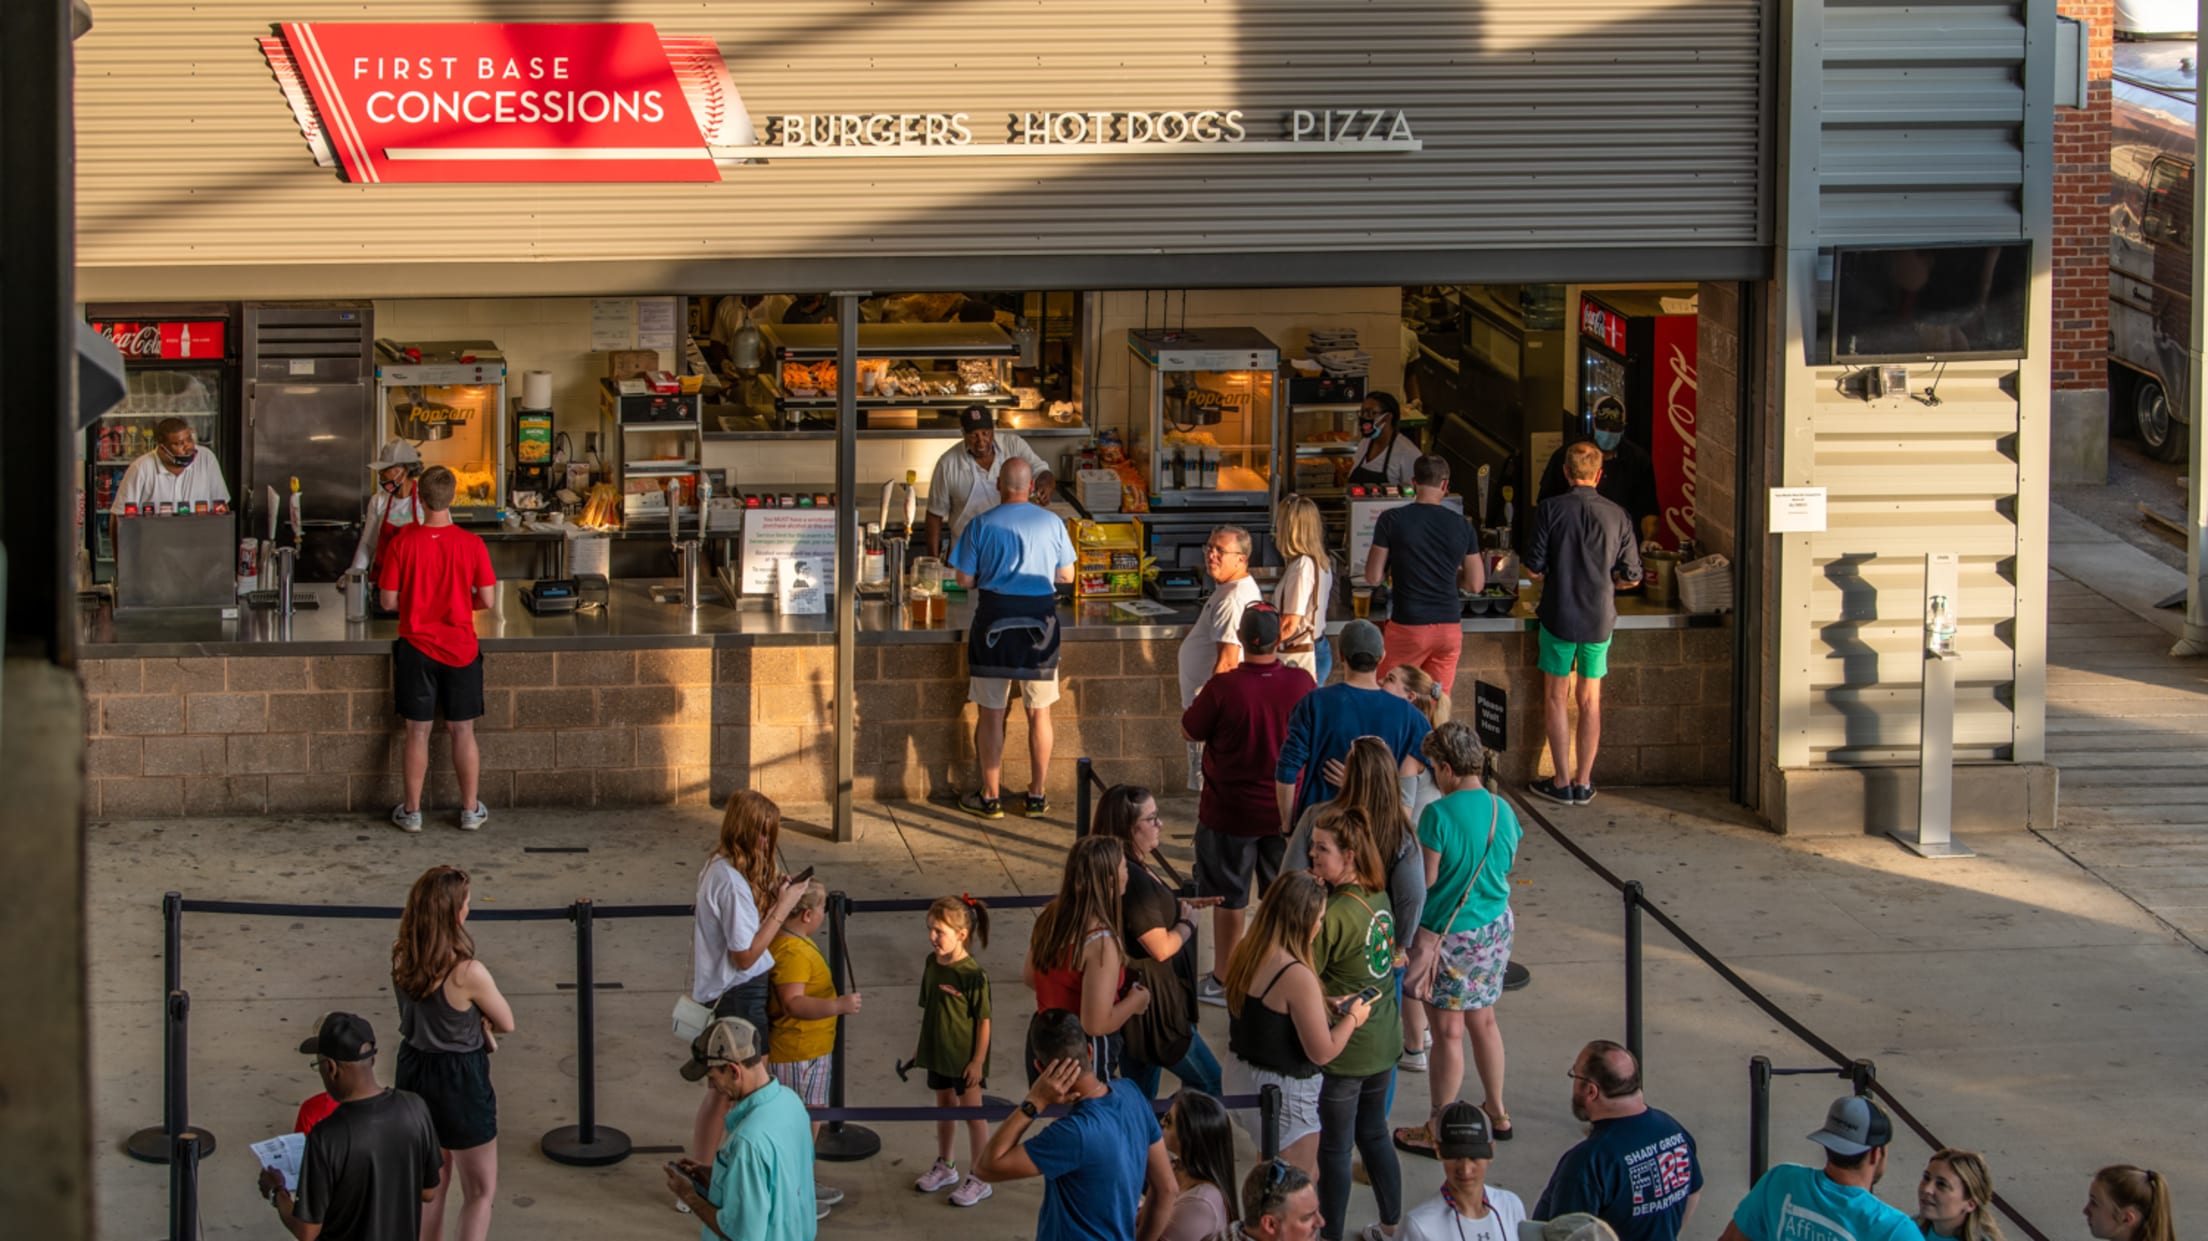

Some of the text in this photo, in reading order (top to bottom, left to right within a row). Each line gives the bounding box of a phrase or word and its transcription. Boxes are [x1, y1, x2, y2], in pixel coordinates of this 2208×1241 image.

[354, 57, 570, 79] FIRST BASE
[366, 90, 665, 124] CONCESSIONS
[782, 109, 1413, 147] BURGERS HOT DOGS PIZZA
[1185, 389, 1250, 407] Popcorn
[409, 405, 475, 426] Popcorn
[1477, 696, 1503, 713] Please
[1482, 707, 1499, 722] Wait
[1481, 719, 1500, 734] Here
[1624, 1143, 1658, 1166] SHADY
[1628, 1143, 1691, 1205] FIRE
[1632, 1184, 1690, 1217] DEPARTMEN
